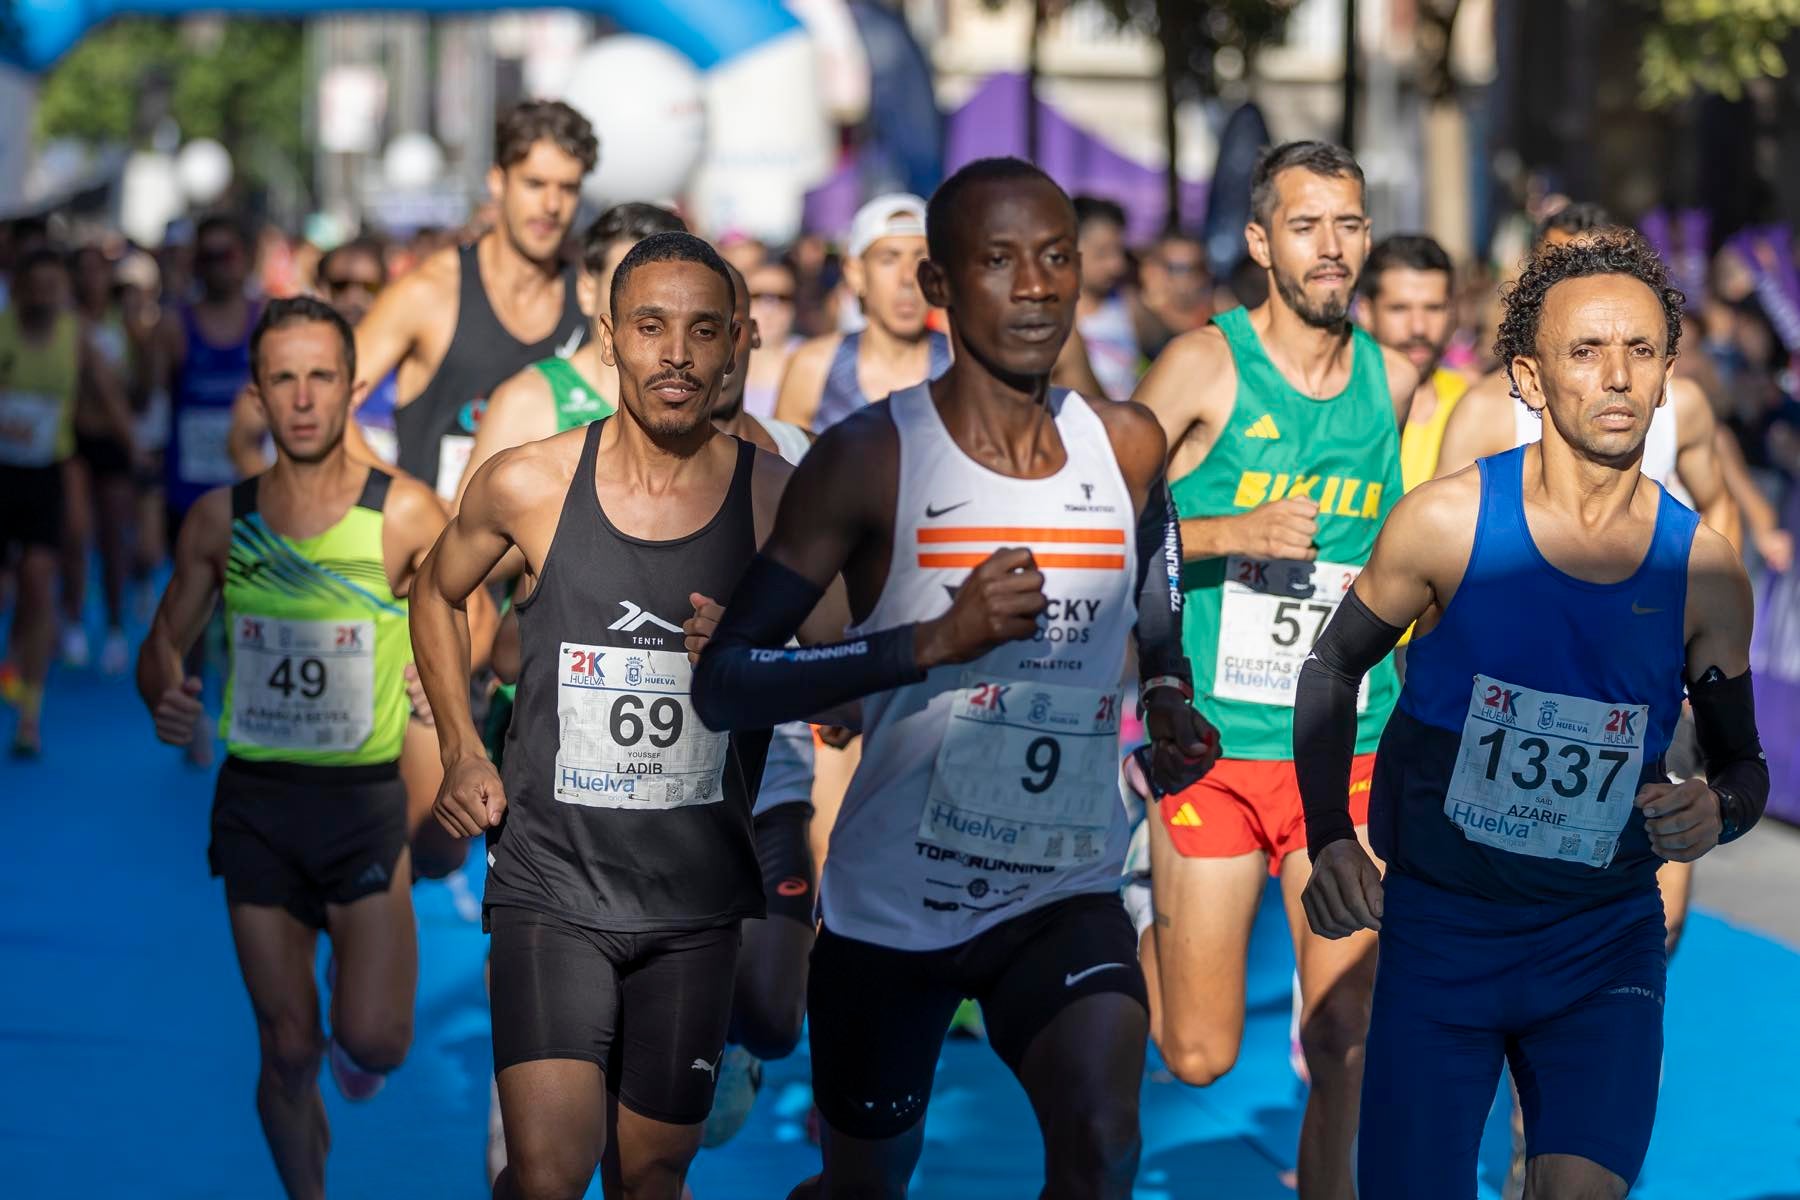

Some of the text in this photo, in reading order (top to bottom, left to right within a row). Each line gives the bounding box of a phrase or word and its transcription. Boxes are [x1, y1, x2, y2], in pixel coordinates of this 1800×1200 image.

[1045, 599, 1100, 621] CKY
[632, 636, 664, 646] TENTH
[1033, 627, 1091, 643] OODS
[571, 650, 606, 677] 21K
[1018, 659, 1082, 670] ATHLETICS
[1224, 656, 1292, 674] CUESTAS
[268, 656, 327, 700] 49
[570, 674, 606, 687] HUELVA
[645, 676, 676, 687] HUELVA
[970, 682, 1011, 713] 21K
[1095, 693, 1117, 723] 21K
[1483, 684, 1523, 717] 21K
[609, 694, 684, 748] 69
[1481, 706, 1517, 726] HUELVA
[1605, 709, 1639, 736] 21K
[1555, 721, 1588, 735] HUELVA
[1603, 734, 1634, 745] HUELVA
[628, 751, 661, 759] YOUSSEF
[1021, 736, 1061, 794] 9
[1479, 728, 1629, 803] 1337
[617, 762, 663, 774] LADIB
[562, 769, 635, 793] Huelva
[932, 804, 1017, 844] Huelva
[1452, 802, 1530, 839] Huelva
